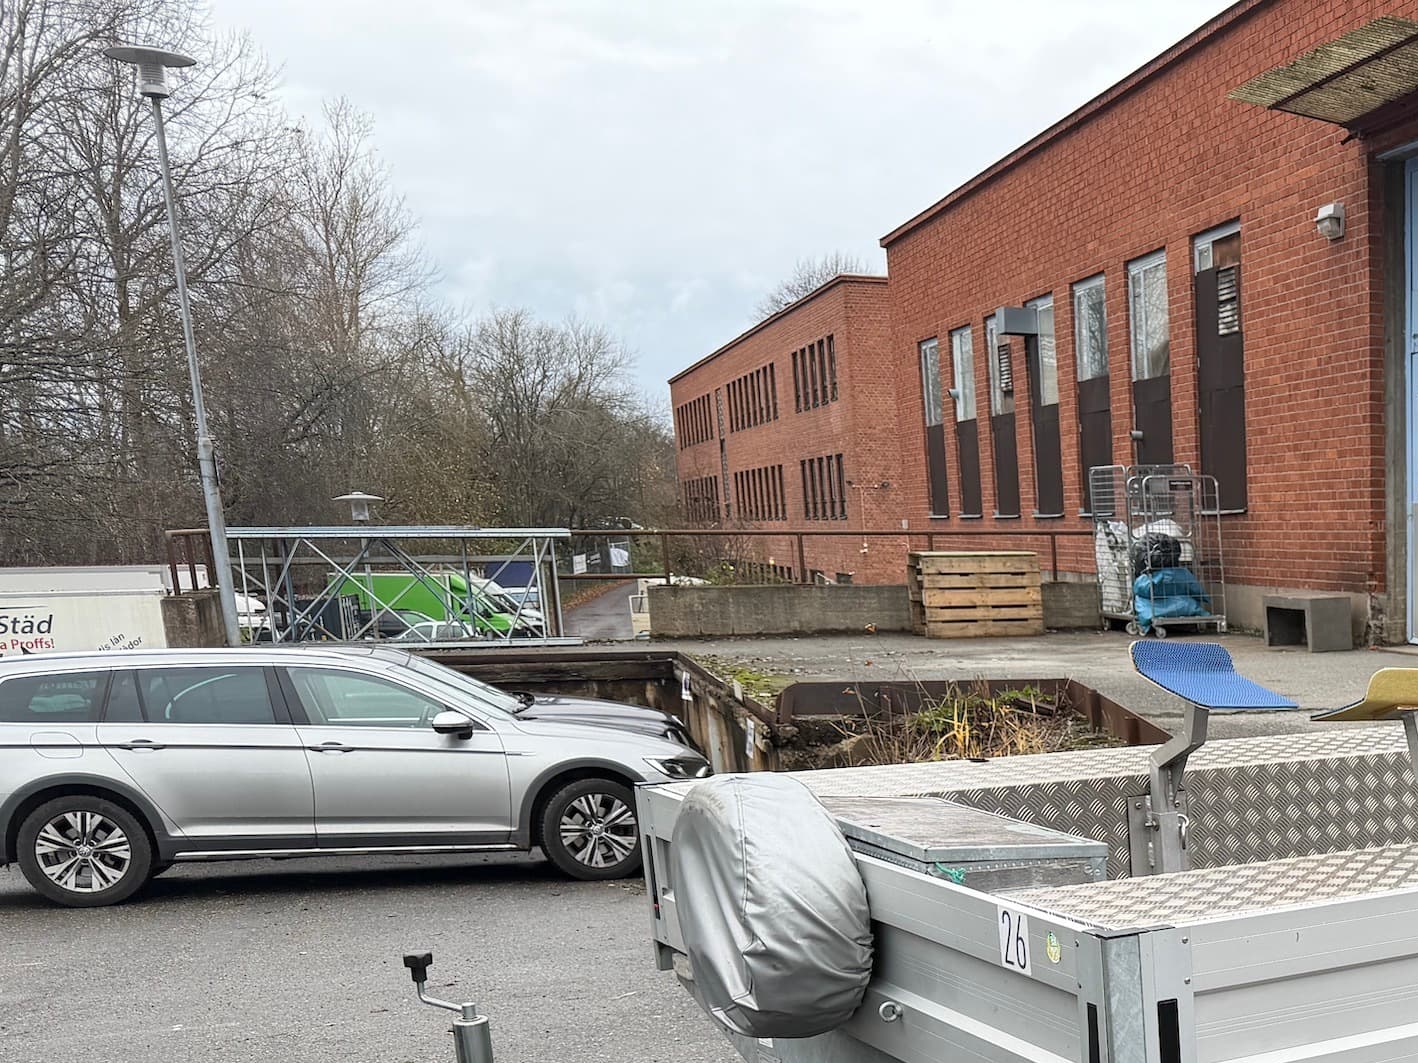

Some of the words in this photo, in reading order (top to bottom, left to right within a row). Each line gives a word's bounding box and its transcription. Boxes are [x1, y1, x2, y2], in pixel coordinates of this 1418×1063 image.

[0, 614, 53, 634] Städ
[10, 637, 55, 650] Proffs!
[1001, 910, 1028, 970] 26
